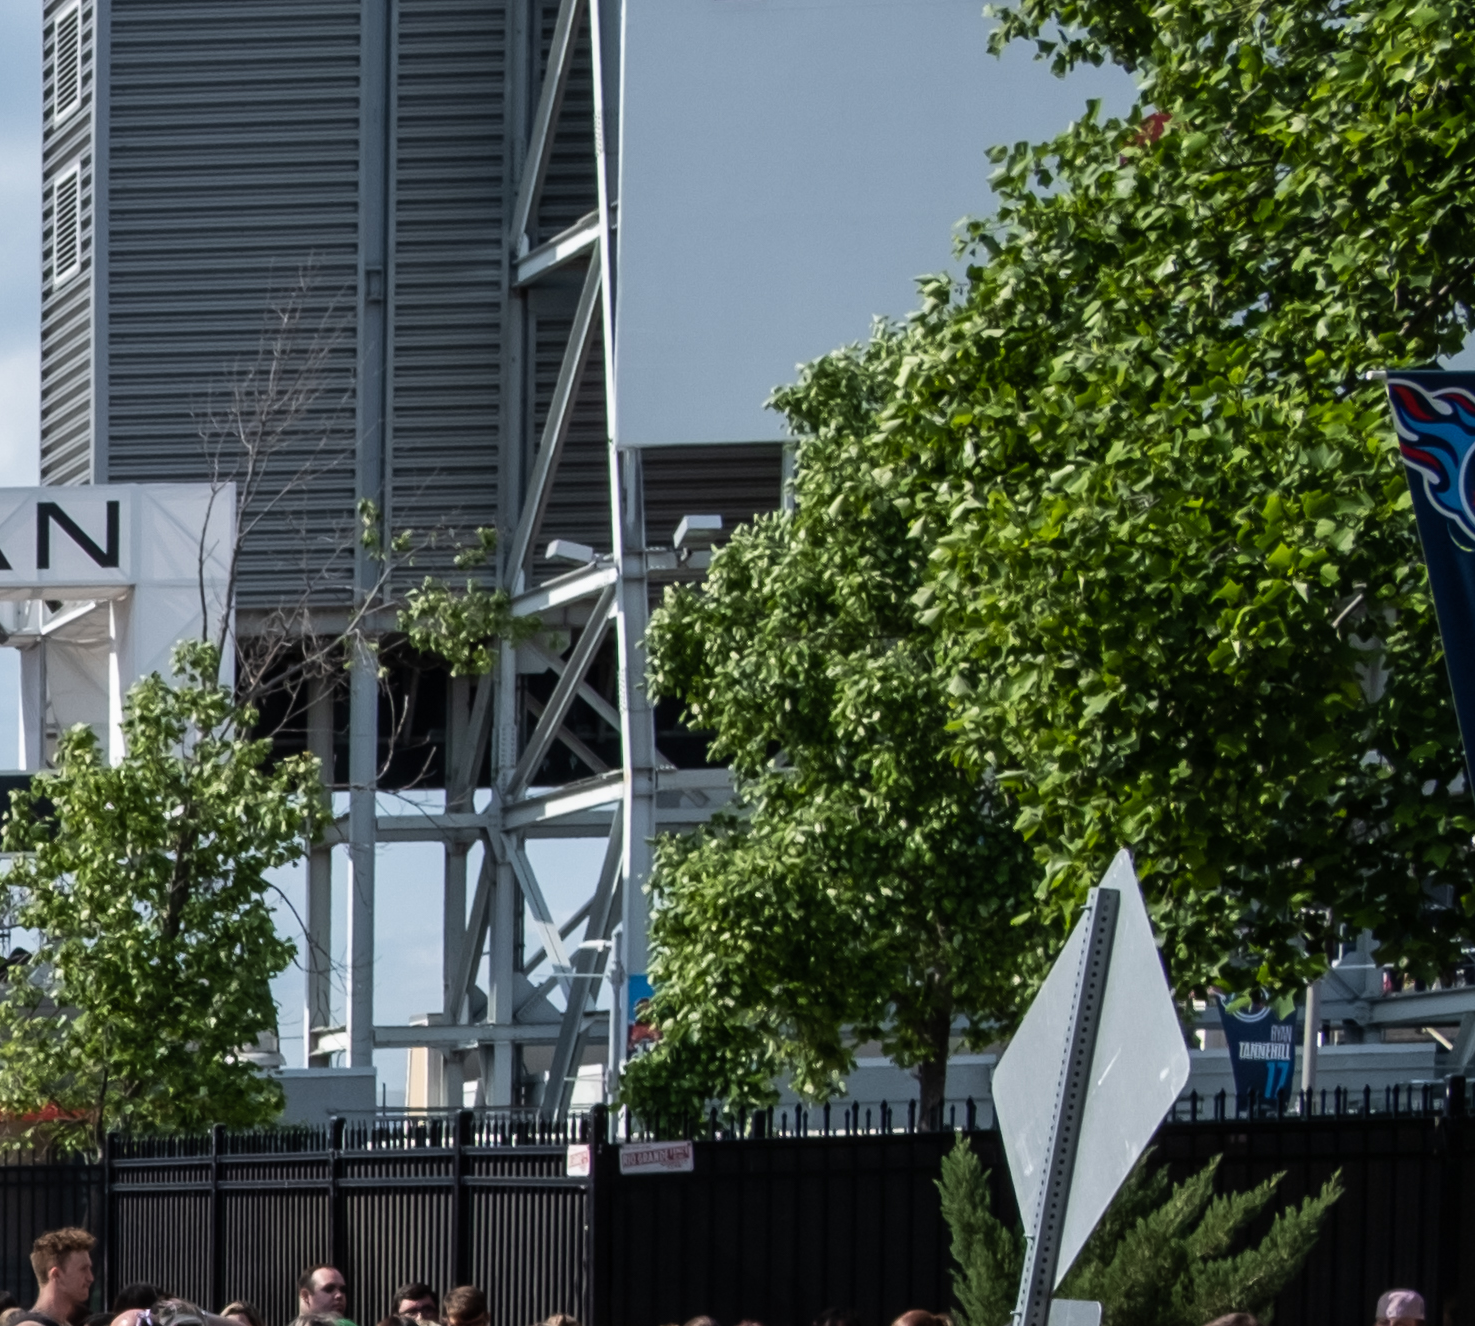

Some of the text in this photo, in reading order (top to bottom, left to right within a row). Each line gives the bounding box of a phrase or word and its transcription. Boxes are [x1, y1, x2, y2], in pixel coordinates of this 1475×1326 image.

[1271, 1024, 1293, 1042] RYAN
[1239, 1042, 1291, 1060] TANNEHILL
[1265, 1061, 1290, 1099] 17
